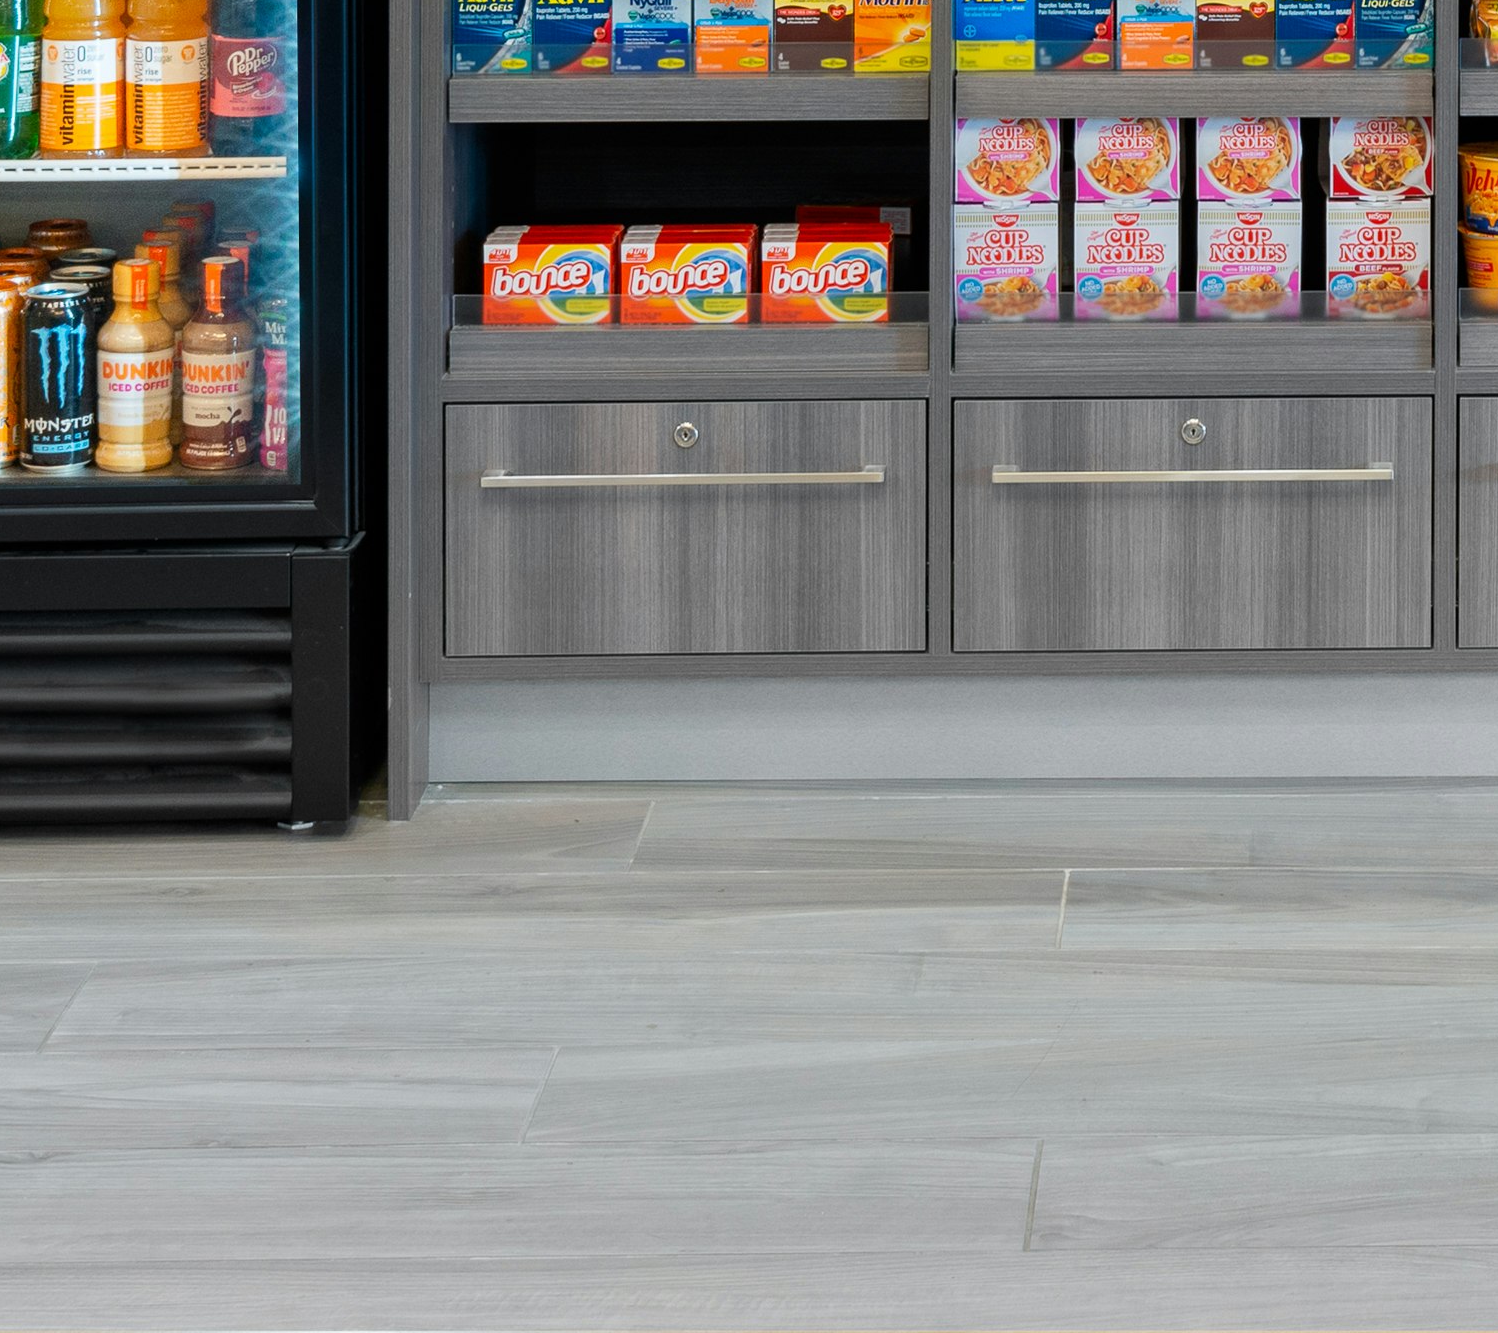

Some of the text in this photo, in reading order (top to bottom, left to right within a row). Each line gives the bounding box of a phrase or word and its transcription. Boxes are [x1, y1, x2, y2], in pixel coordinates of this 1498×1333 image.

[244, 45, 261, 62] Dr
[227, 49, 276, 76] Pepper
[991, 125, 1023, 140] CUP
[1110, 123, 1142, 139] CUP
[979, 136, 1035, 153] NOODLES
[1099, 135, 1155, 152] NOODLES
[493, 260, 592, 298] bounce
[630, 259, 730, 298] bounce
[769, 259, 870, 297] bounce
